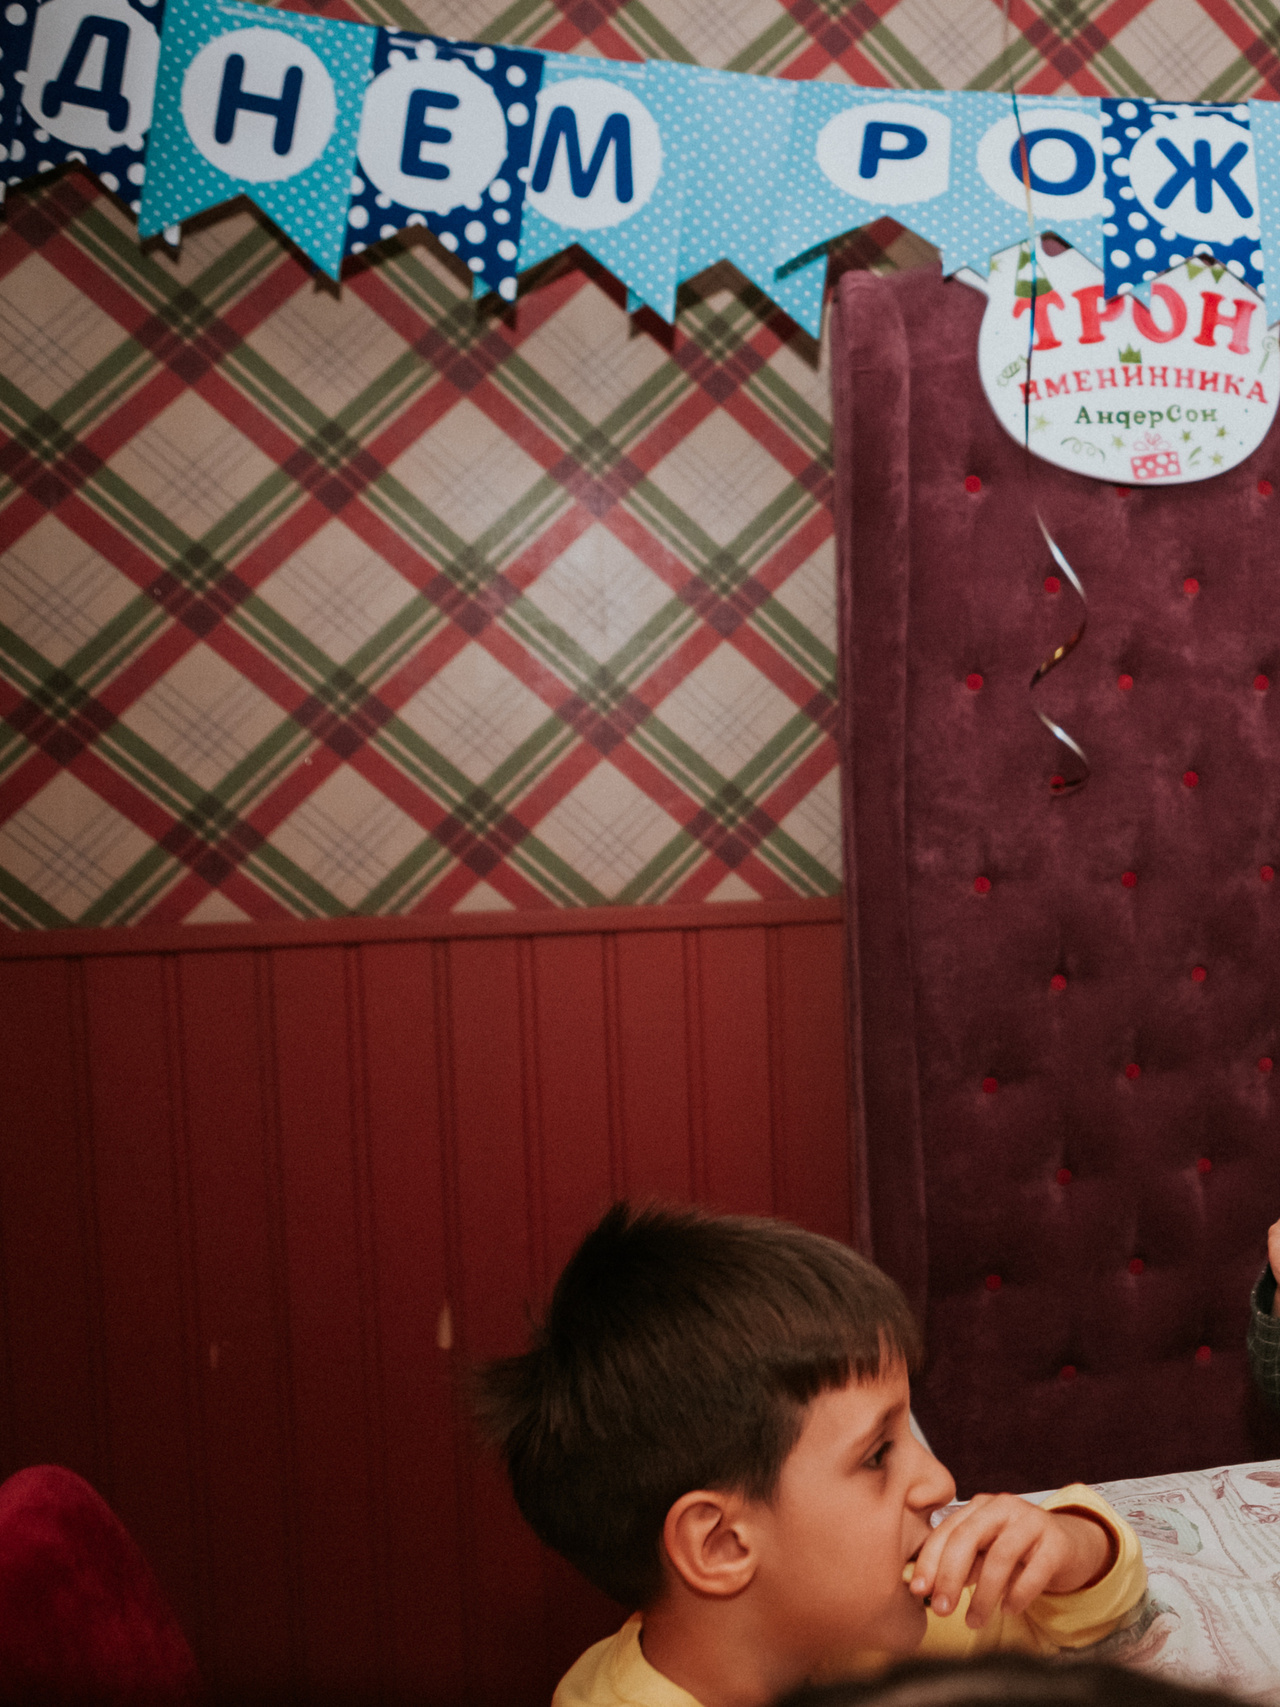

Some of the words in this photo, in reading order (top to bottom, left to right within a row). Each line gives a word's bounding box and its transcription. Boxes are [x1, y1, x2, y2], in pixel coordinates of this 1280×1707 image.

[41, 14, 635, 204] ДНЕМ
[1012, 283, 1258, 355] ТРОН
[1018, 364, 1268, 404] ИМЕНИННИКА
[1074, 404, 1218, 429] АндерСон
